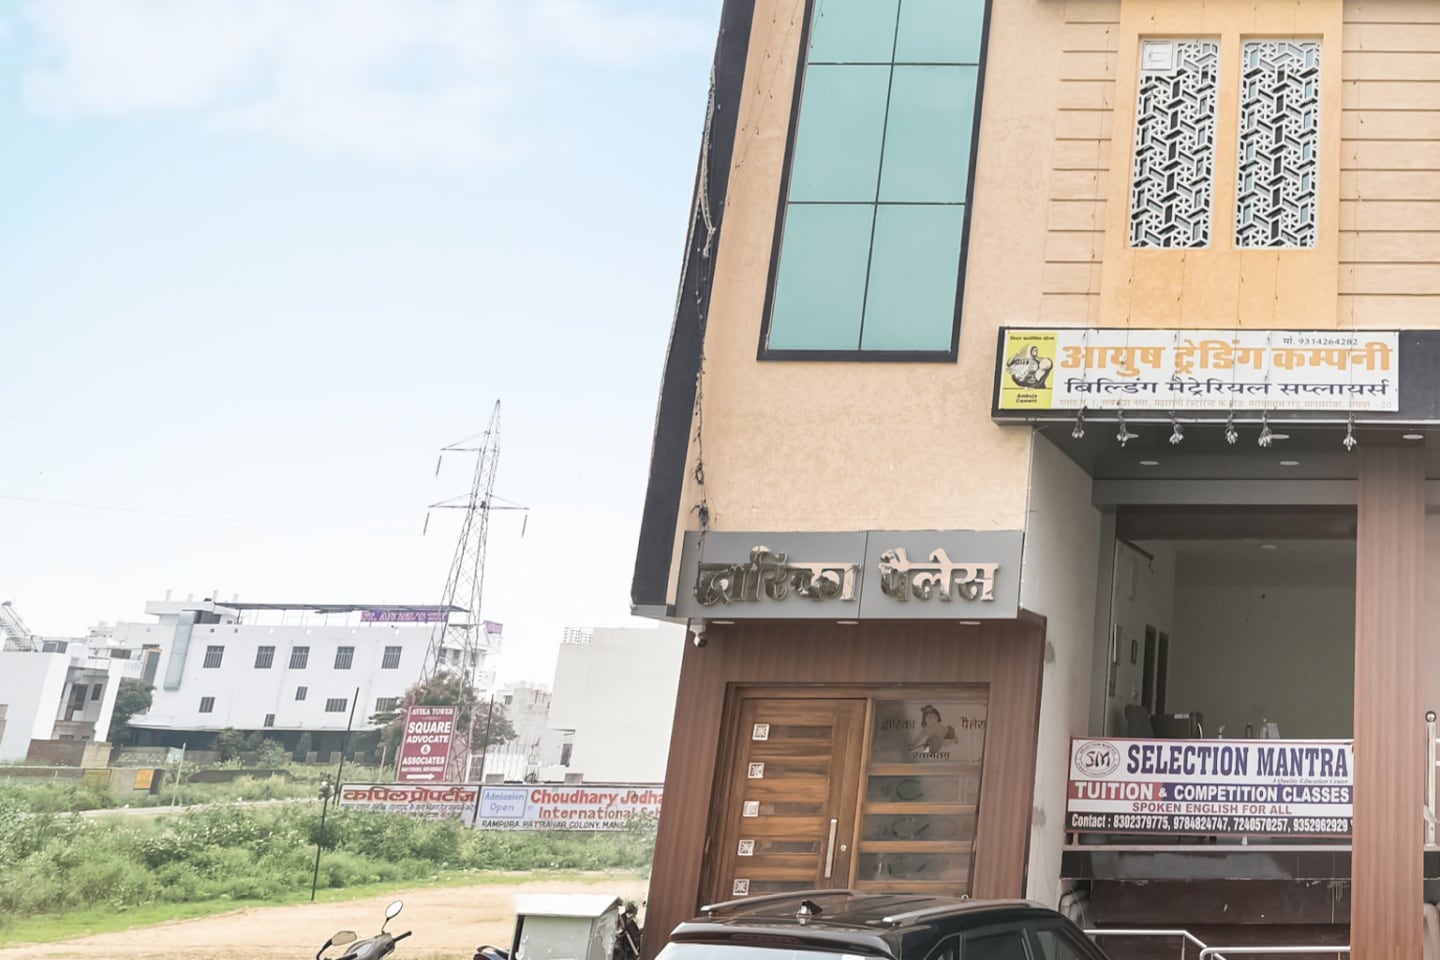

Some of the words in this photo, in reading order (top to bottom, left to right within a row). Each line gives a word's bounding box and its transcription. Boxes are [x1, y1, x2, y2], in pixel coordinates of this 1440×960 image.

[1060, 345, 1166, 377] आयुष
[1173, 339, 1266, 375] ट्रेडिंग
[1272, 341, 1393, 371] कम्पनी
[1064, 378, 1158, 394] बिल्डिंग
[1277, 379, 1390, 396] सप्लायर्स
[408, 721, 451, 734] SQUARE
[406, 735, 449, 744] ADVOCATE
[402, 756, 445, 765] ASSOCIATES
[1127, 744, 1248, 775] SELECTION
[1257, 747, 1348, 777] MANTRA
[484, 791, 525, 801] Admission
[530, 789, 619, 809] Choudhary
[1075, 782, 1153, 800] TUITION
[1158, 788, 1167, 798] &
[1174, 785, 1277, 802] COMPETITION
[1282, 787, 1349, 803] CLASSES
[490, 802, 514, 813] Open
[539, 806, 635, 819] International
[1132, 802, 1181, 813] SPOKEN
[1186, 804, 1238, 814] ENGLISH
[1242, 805, 1266, 814] FOR
[1270, 806, 1292, 815] ALL
[481, 820, 519, 828] RAMPURA
[1072, 814, 1106, 827] Contact
[1293, 818, 1349, 832] 9352962929
